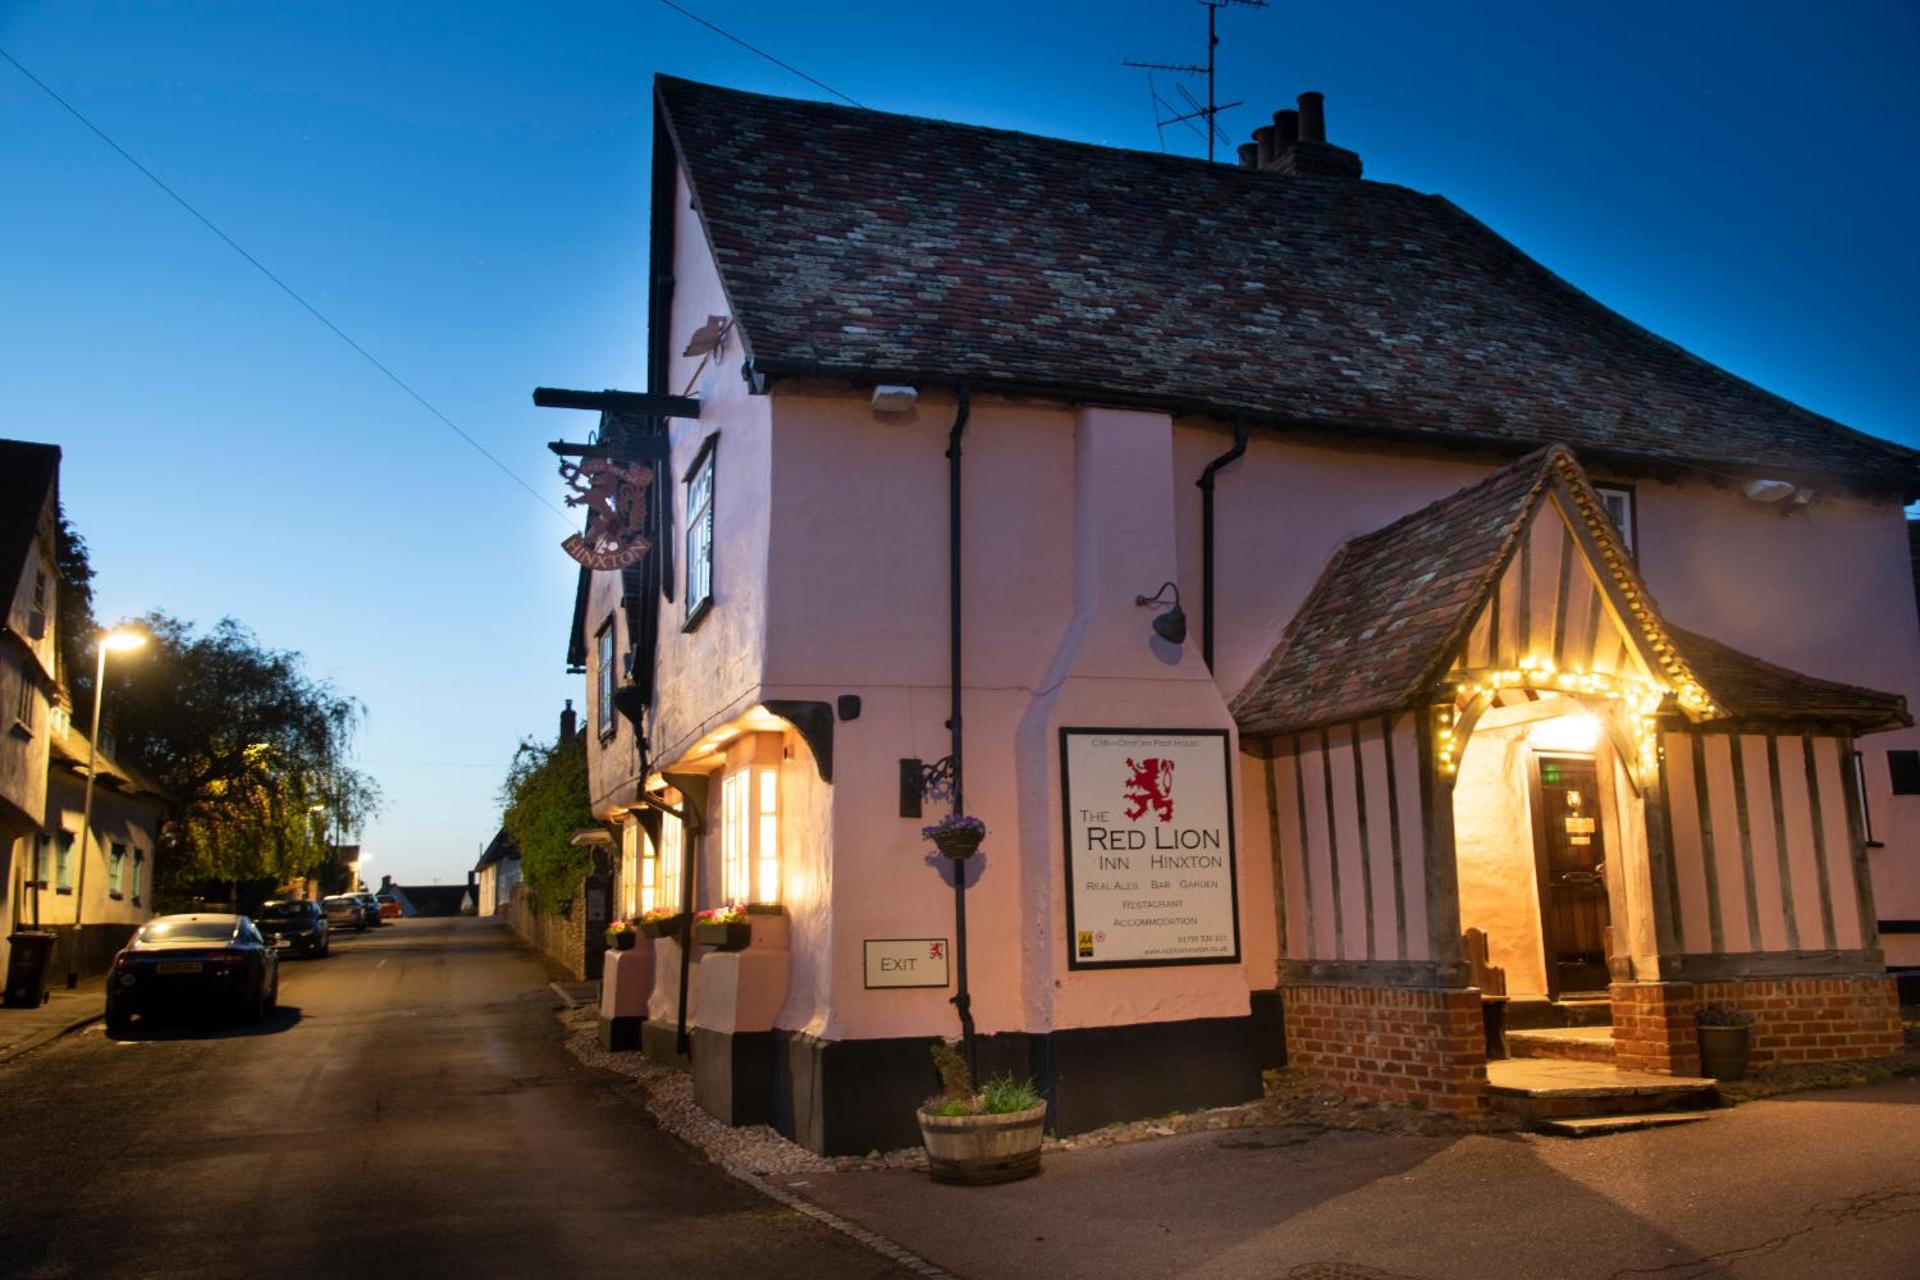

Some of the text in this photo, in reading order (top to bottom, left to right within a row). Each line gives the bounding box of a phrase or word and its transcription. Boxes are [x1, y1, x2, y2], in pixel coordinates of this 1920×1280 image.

[566, 537, 648, 569] HINXTON
[1080, 809, 1110, 823] THE
[1087, 826, 1221, 851] RED LION
[1099, 854, 1223, 870] INN HINXTON
[1086, 880, 1219, 891] REAL ALES BAR GARDEN
[1122, 899, 1184, 910] RESTAURANT
[1113, 916, 1198, 928] ACCOMMODATION
[880, 957, 918, 972] EXIT
